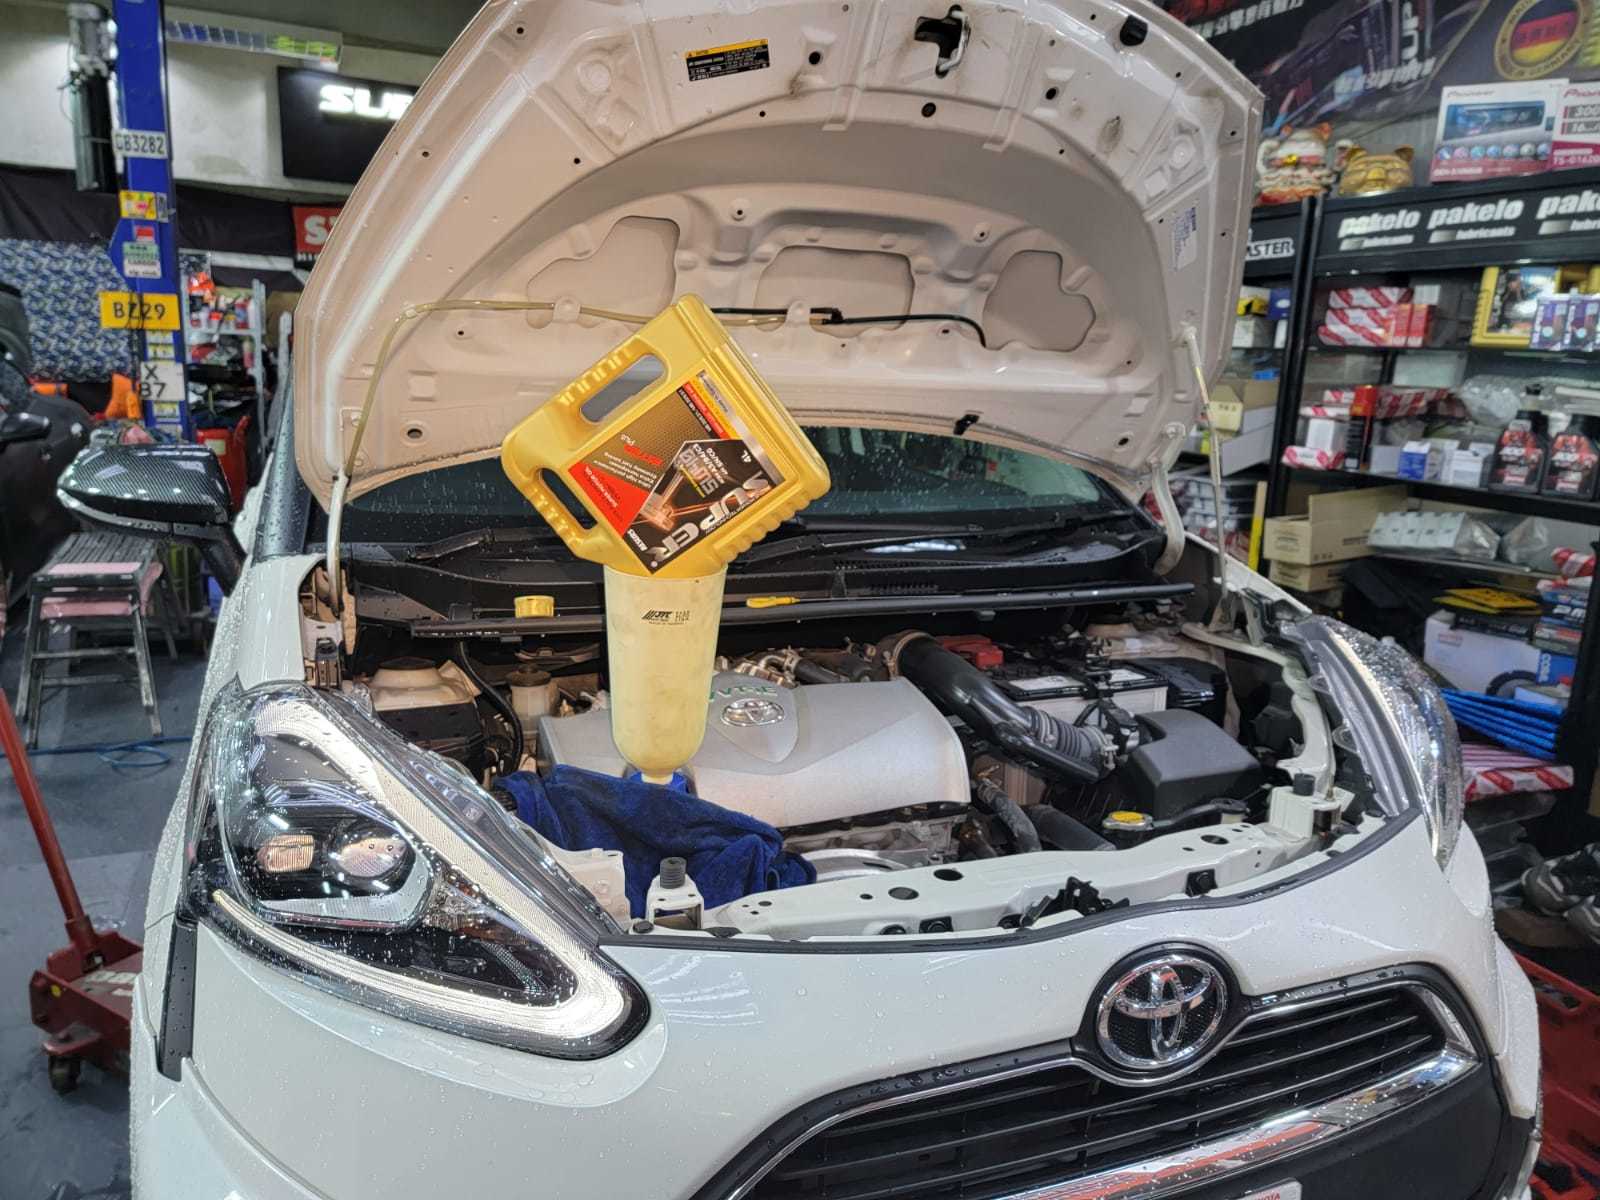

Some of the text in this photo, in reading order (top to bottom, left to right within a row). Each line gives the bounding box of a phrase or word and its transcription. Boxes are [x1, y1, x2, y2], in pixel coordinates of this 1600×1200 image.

[1338, 209, 1419, 238] pakelo
[1427, 198, 1524, 229] pakelo
[1456, 226, 1516, 240] lubricants
[1246, 240, 1292, 258] ASTER
[740, 450, 752, 463] 4L
[648, 468, 772, 562] SUPER
